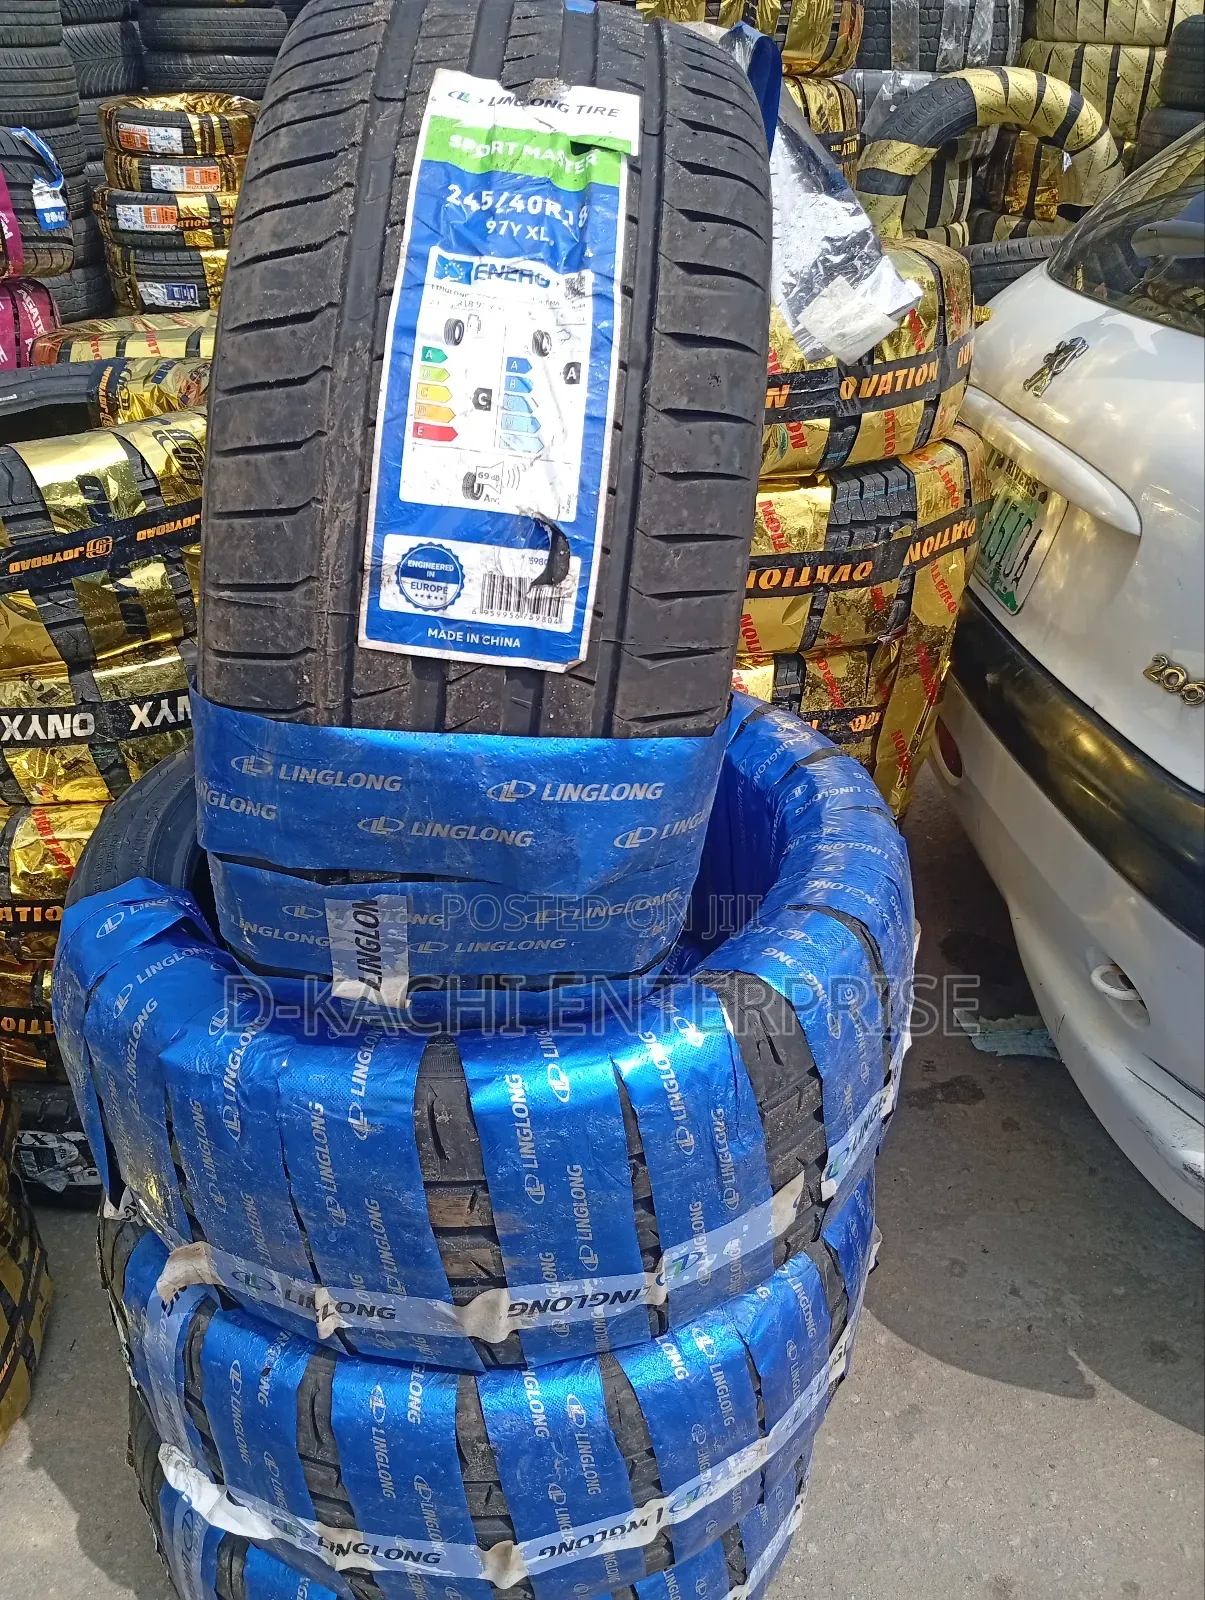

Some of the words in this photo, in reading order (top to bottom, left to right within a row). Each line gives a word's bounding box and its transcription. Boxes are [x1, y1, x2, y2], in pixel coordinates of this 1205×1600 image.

[577, 103, 621, 118] TIRE
[448, 134, 520, 160] SPORT
[522, 142, 599, 176] MASTER
[485, 220, 522, 238] 97Y
[526, 224, 550, 243] XL
[473, 262, 551, 289] ENERG
[838, 359, 939, 401] OVATION
[477, 471, 490, 480] 69
[1005, 460, 1039, 498] RIVERS
[136, 514, 200, 541] JOYROAD
[9, 546, 85, 574] JOYROAD
[407, 559, 455, 573] ENGINEERED
[426, 570, 436, 578] IN
[410, 581, 449, 595] EUROPE
[427, 627, 464, 643] MADE
[466, 632, 480, 645] IN
[484, 635, 522, 649] CHINA
[1143, 652, 1205, 706] 206
[0, 711, 96, 742] ONYX
[279, 764, 403, 792] LINGLONG
[541, 781, 665, 802] LINGLONG
[410, 820, 534, 848] LINGLONG
[571, 888, 681, 921] LINGLONG
[230, 913, 334, 947] LINGLONG
[455, 938, 568, 953] LINGLONG
[125, 997, 159, 1089] LINGLONG
[223, 1016, 268, 1103] LINGLONG
[638, 1029, 689, 1122] LINGLONG
[505, 1073, 539, 1170] LINGLONG
[189, 1098, 219, 1182] LINGLONG
[309, 1100, 339, 1195] LINGLONG
[709, 1107, 739, 1186] LINGLONG
[566, 1163, 593, 1242] LINGLONG
[365, 1197, 396, 1278] LINGLONG
[507, 1285, 653, 1320] LINGLONG
[709, 1363, 736, 1427] LINGLONG
[230, 1392, 253, 1466] LINGLONG
[371, 1427, 397, 1500] LINGLONG
[574, 1433, 602, 1496] LINGLONG
[317, 1536, 442, 1564] LINGLONG
